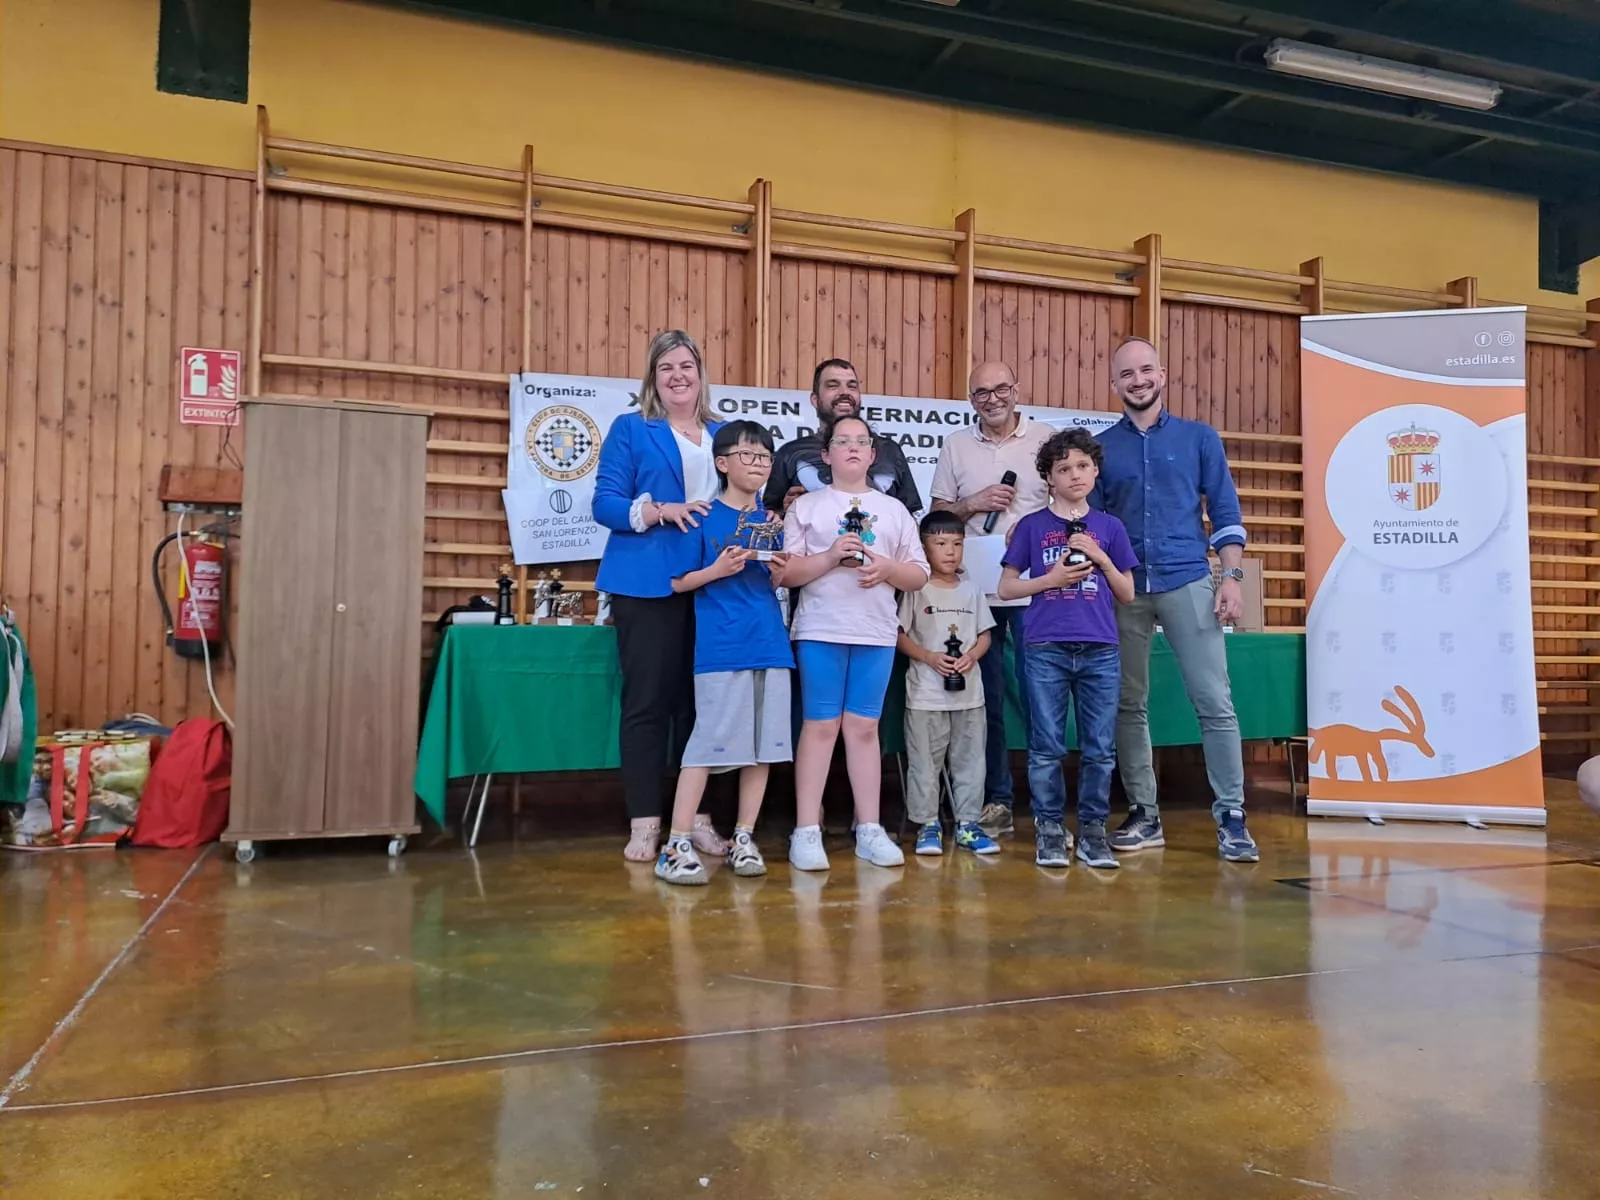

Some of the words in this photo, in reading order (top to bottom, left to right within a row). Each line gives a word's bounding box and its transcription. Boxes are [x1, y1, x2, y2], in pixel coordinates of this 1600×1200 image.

[1446, 354, 1516, 367] estadilla.es
[524, 384, 597, 398] Organiza:
[717, 398, 800, 416] OPEN
[860, 406, 982, 426] ERNACI
[520, 518, 549, 529] COOP
[552, 517, 569, 526] DEL
[571, 515, 593, 525] CAM
[1373, 518, 1444, 530] Ayuntamiento
[1446, 517, 1460, 528] de
[532, 530, 552, 539] SAN
[553, 526, 598, 538] LORENZO
[1373, 531, 1459, 545] ESTADILLA
[541, 538, 591, 550] ESTADILLA
